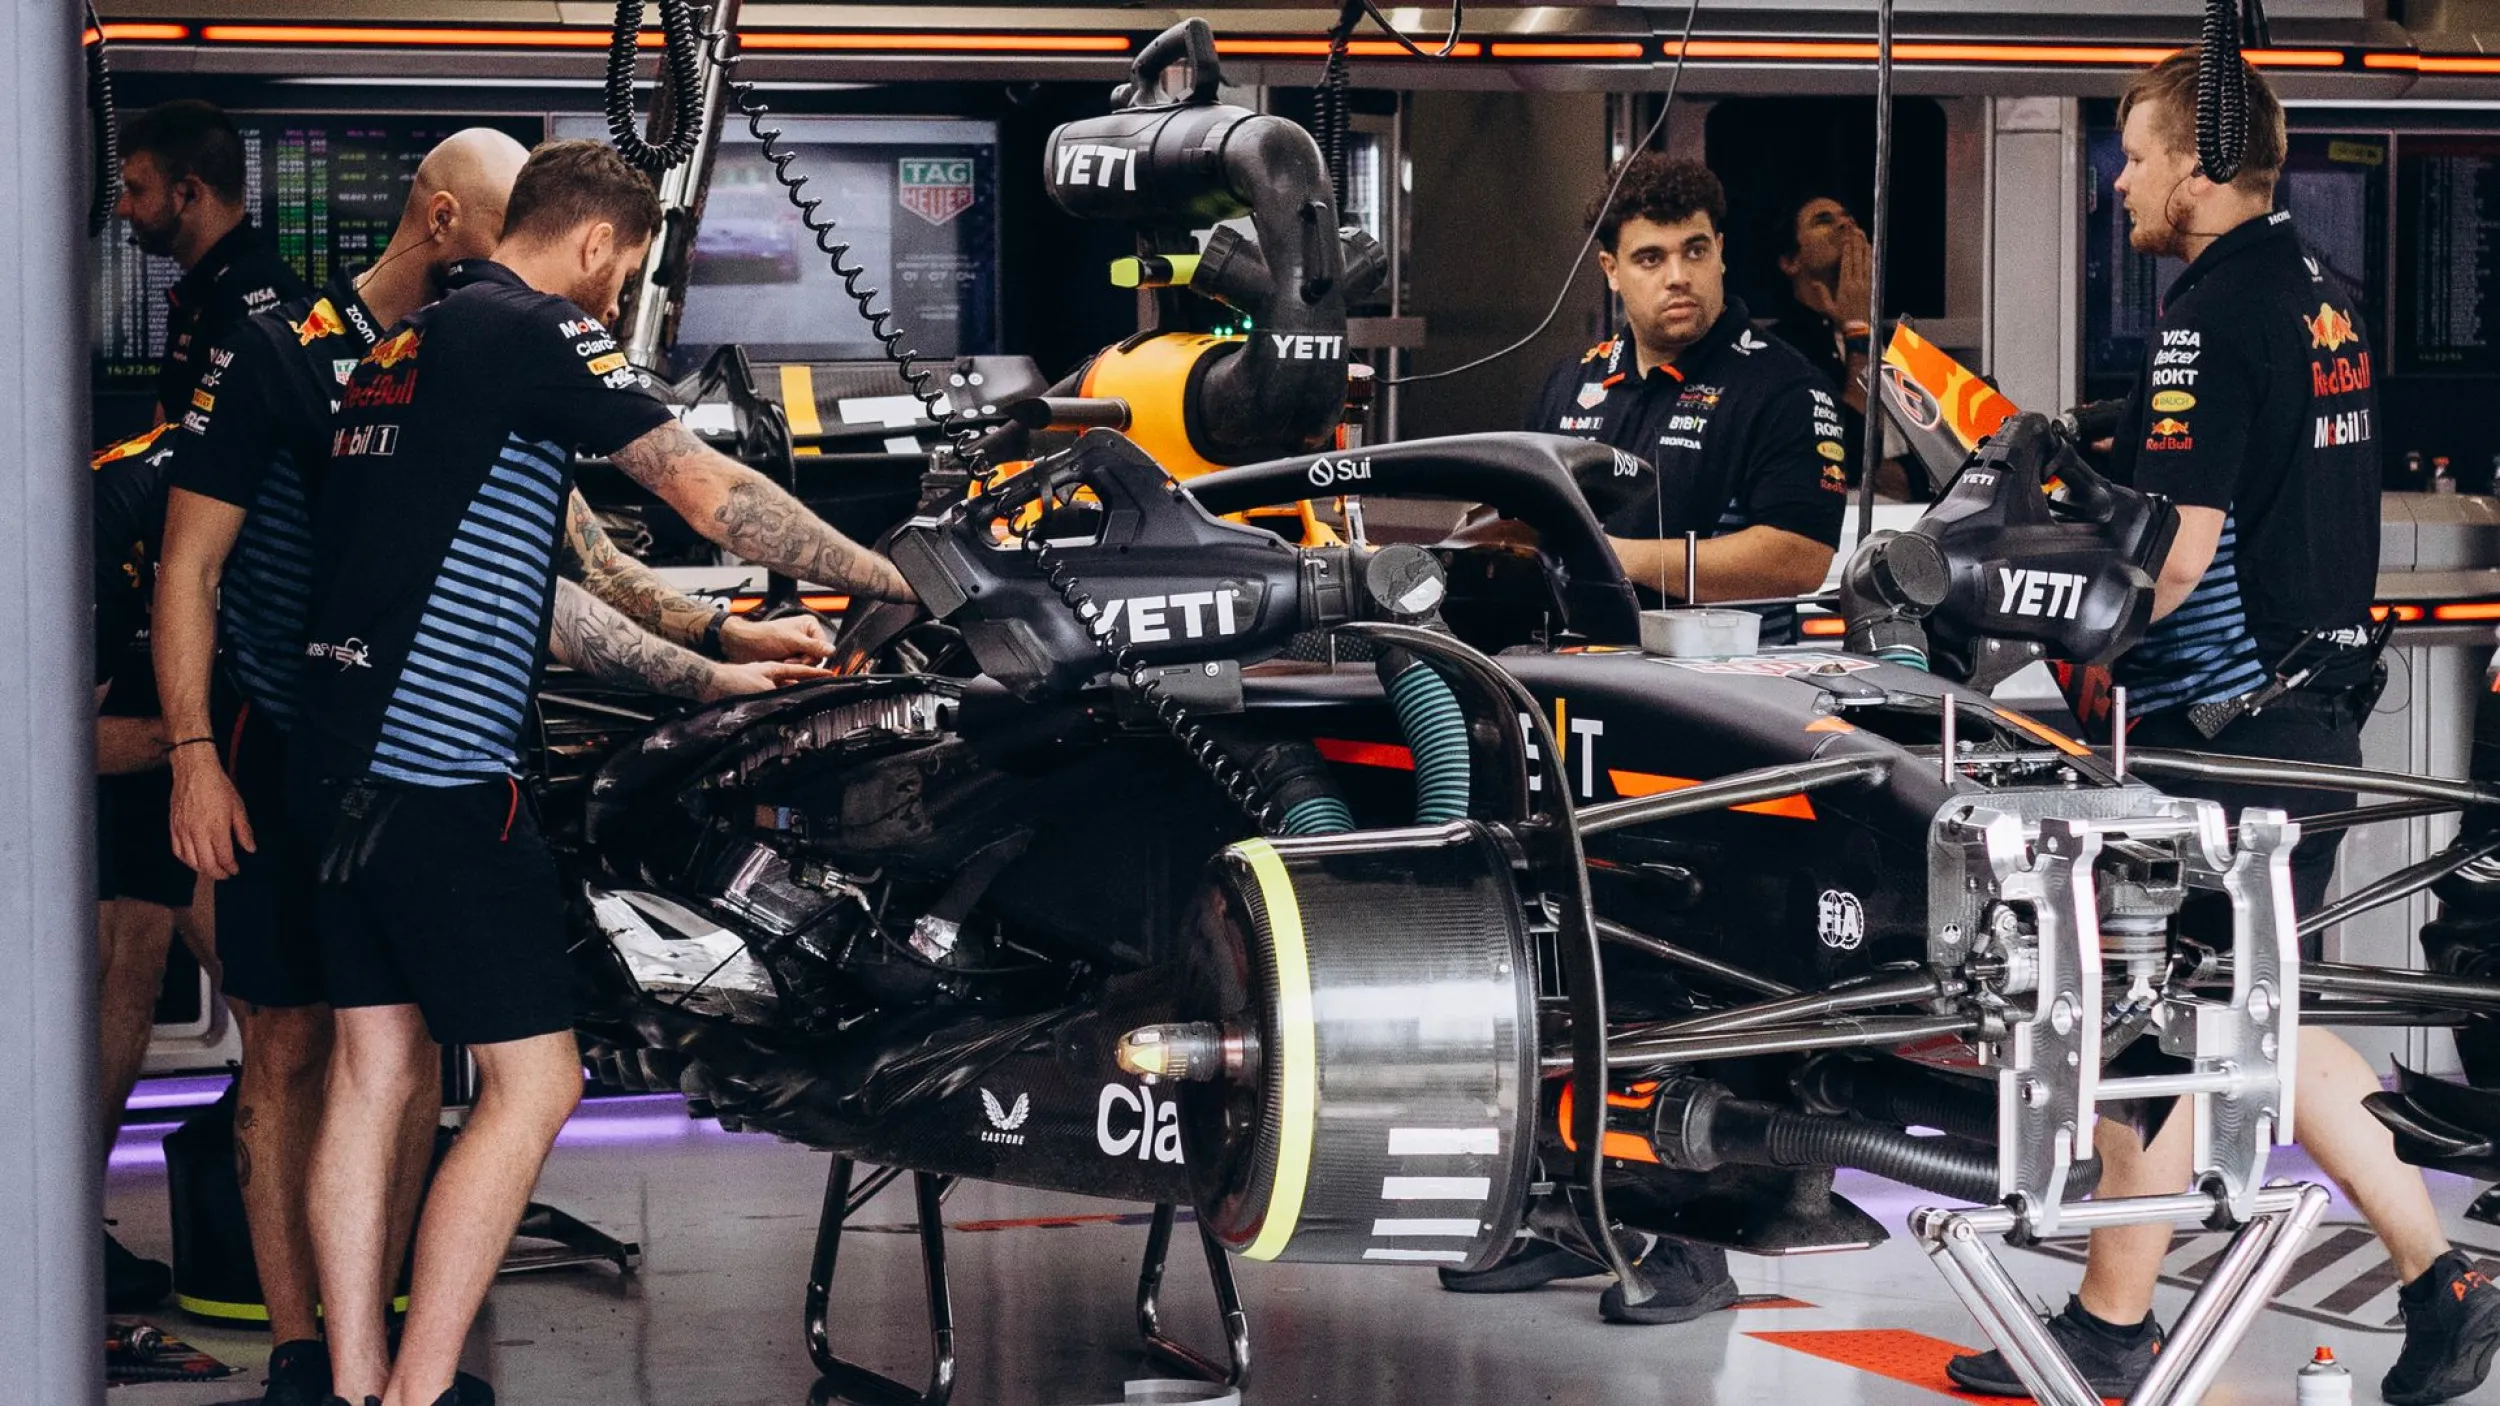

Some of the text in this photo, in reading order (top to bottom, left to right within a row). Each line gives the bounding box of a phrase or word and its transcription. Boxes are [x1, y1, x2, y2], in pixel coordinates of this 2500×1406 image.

[905, 163, 967, 182] TAG
[1055, 145, 1137, 191] YETI
[903, 189, 970, 219] HEUER
[242, 286, 277, 305] VISA
[345, 303, 377, 345] zoom
[558, 317, 606, 339] Mob
[1271, 334, 1343, 360] YETI
[2161, 329, 2201, 348] VISA
[2152, 368, 2199, 387] ROKT
[2311, 352, 2372, 398] Red Bull
[2314, 411, 2360, 449] Mobil
[1659, 436, 1702, 450] HONDA
[2145, 436, 2194, 452] Red Bull
[1336, 456, 1372, 481] Sui
[1961, 473, 1996, 487] YETI
[1999, 567, 2084, 620] YETI
[1081, 589, 1237, 644] YETI
[981, 1130, 1026, 1146] CASTORE
